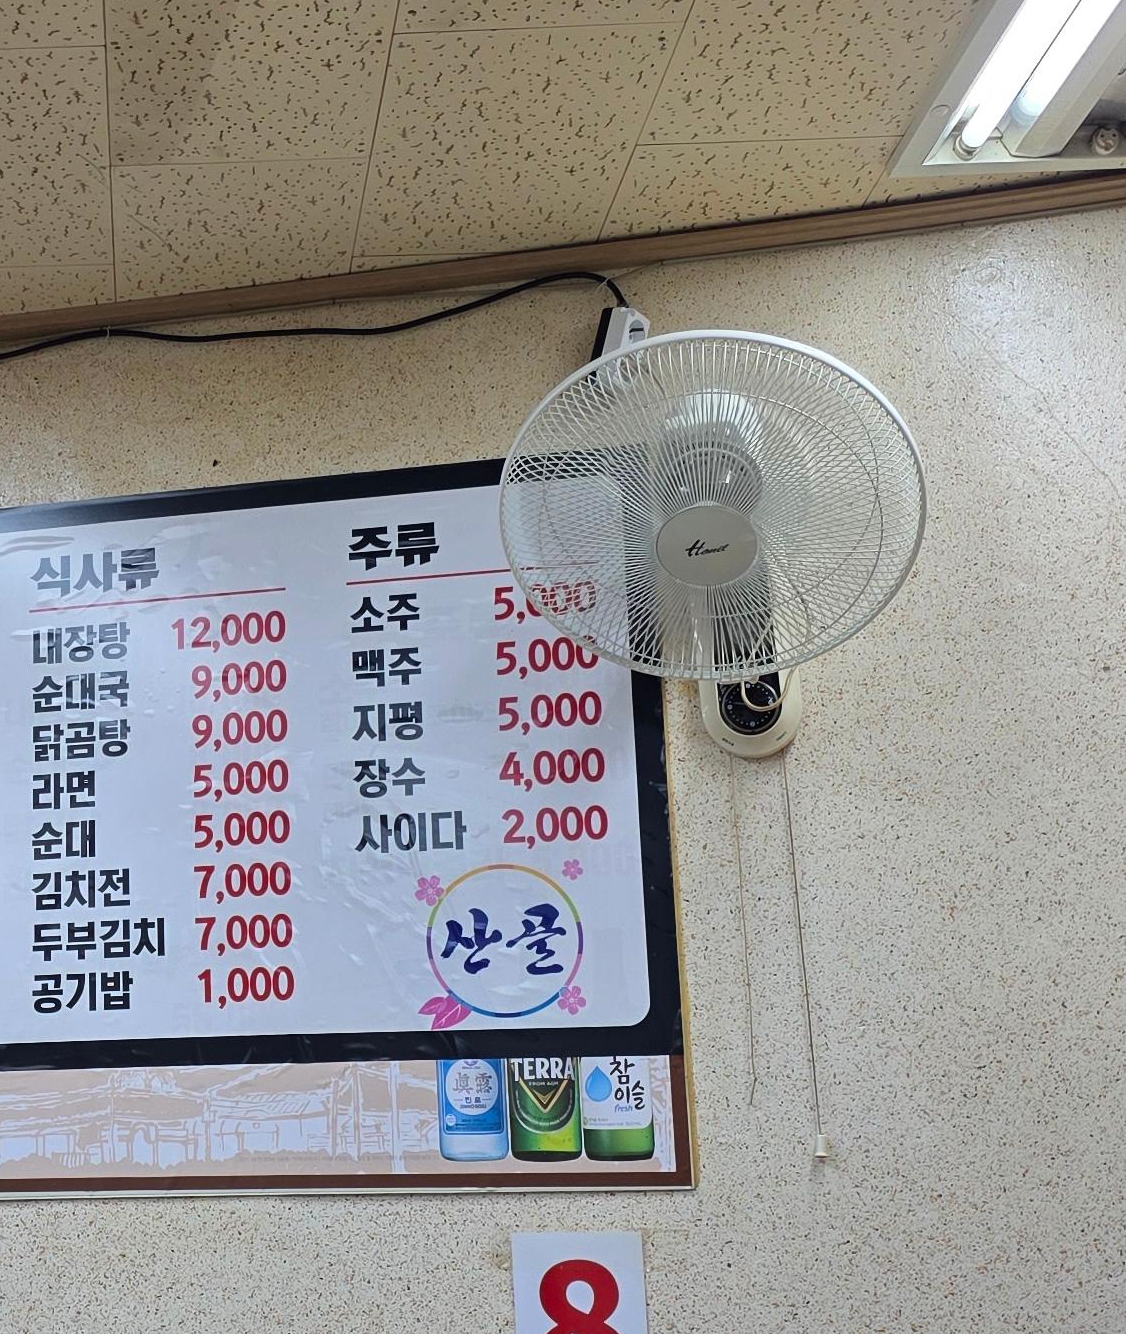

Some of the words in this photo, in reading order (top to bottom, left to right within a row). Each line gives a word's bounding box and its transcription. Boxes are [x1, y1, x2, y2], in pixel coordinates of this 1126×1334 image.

[30, 546, 160, 597] 식사류
[348, 521, 440, 571] 주류
[32, 621, 131, 665] 내장탕
[173, 610, 286, 651] 12,000
[350, 592, 420, 634] 소주
[31, 670, 130, 714] 순대국
[191, 659, 287, 700] 9,000
[351, 646, 422, 688] 맥주
[495, 636, 599, 679] 5,000
[32, 718, 131, 763] 닭곰탕
[190, 709, 288, 751] 9,000
[352, 700, 424, 742] 지평
[497, 690, 602, 735] 5,000
[32, 769, 96, 810] 라면
[191, 759, 289, 801] 5,000
[352, 757, 426, 799] 장수
[498, 748, 605, 792] 4,000
[31, 819, 96, 861] 순대
[192, 810, 291, 854] 5,000
[354, 810, 467, 854] 사이다
[501, 805, 608, 848] 2,000
[31, 868, 131, 911] 김치전
[193, 861, 292, 905] 7,000
[32, 917, 166, 962] 두부김치
[194, 913, 293, 956] 7,000
[31, 970, 134, 1014] 공기밥
[196, 966, 295, 1010] 1,000
[510, 1056, 575, 1081] TERRA
[615, 1104, 633, 1113] fresh
